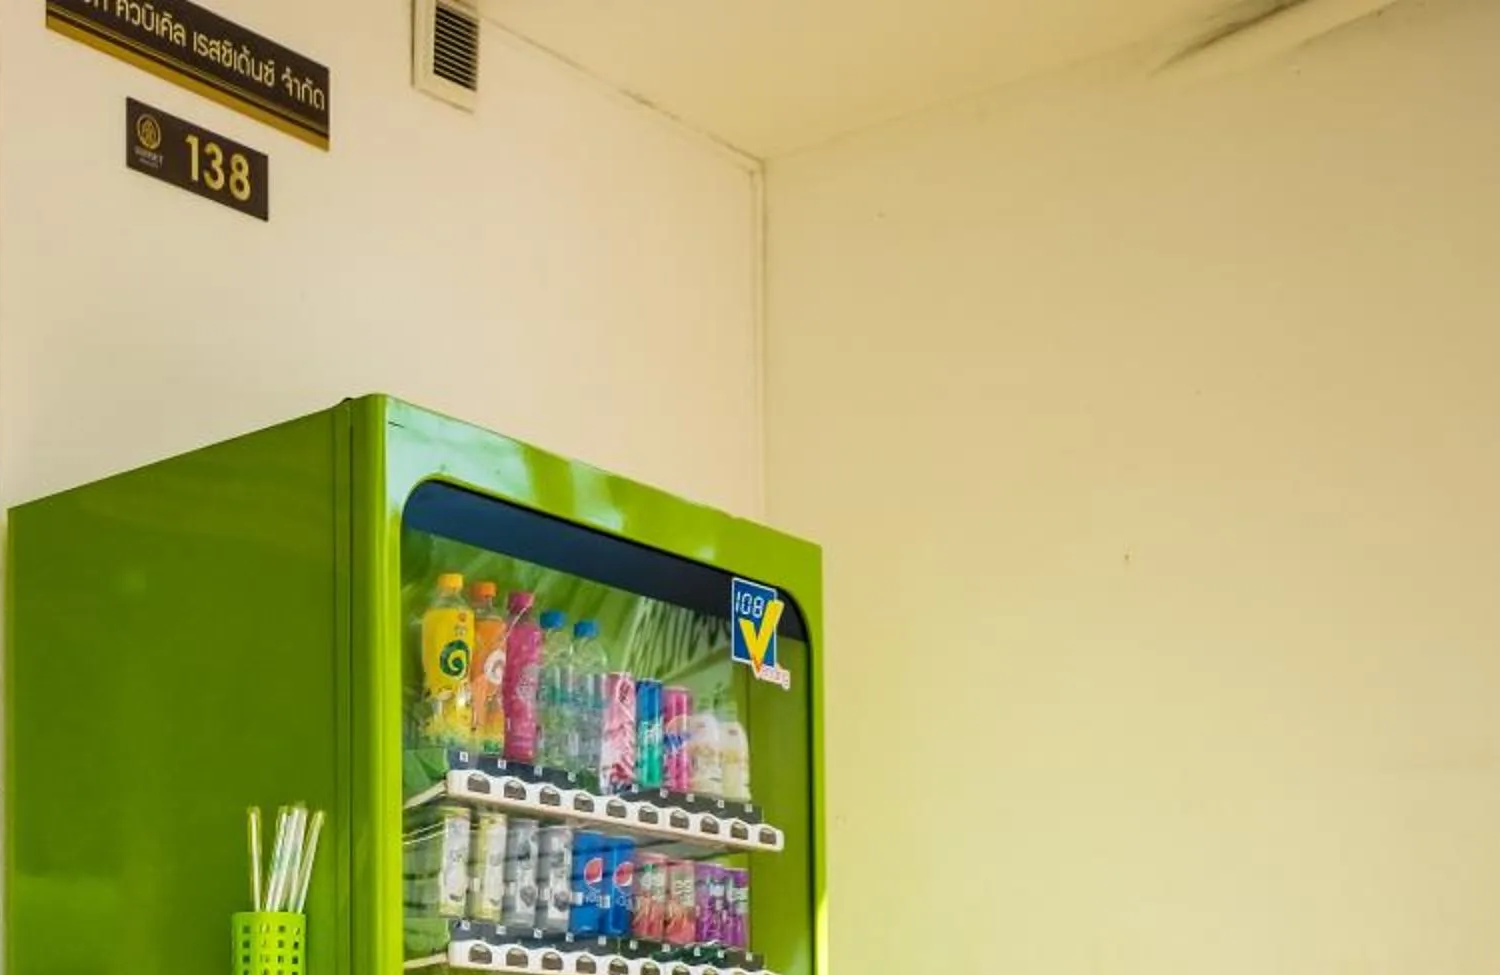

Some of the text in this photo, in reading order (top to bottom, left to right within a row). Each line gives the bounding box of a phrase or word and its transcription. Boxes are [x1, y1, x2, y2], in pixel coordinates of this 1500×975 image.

[281, 66, 326, 111] จำกัด
[185, 133, 252, 202] 138
[736, 591, 765, 619] 108
